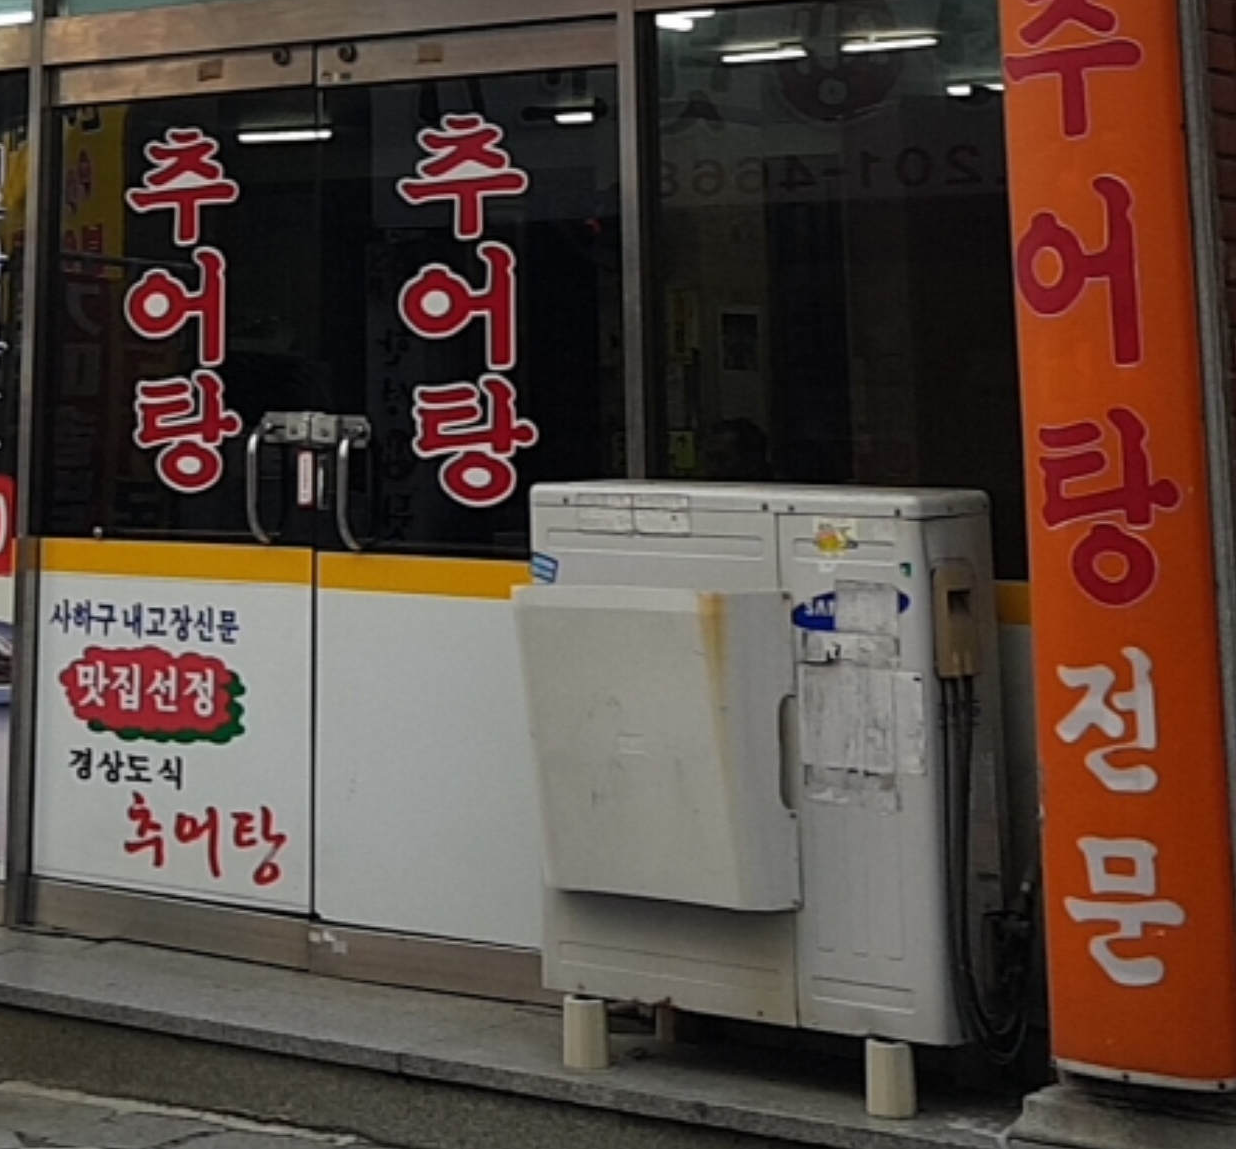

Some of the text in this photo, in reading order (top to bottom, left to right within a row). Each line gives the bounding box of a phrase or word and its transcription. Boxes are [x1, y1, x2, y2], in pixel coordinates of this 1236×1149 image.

[123, 128, 243, 493] 추어탕
[397, 112, 539, 507] 추어탕
[50, 599, 117, 638] 사하구
[74, 660, 217, 718] 맛집선정
[123, 791, 287, 886] 추어탕
[1055, 647, 1186, 986] 전문
